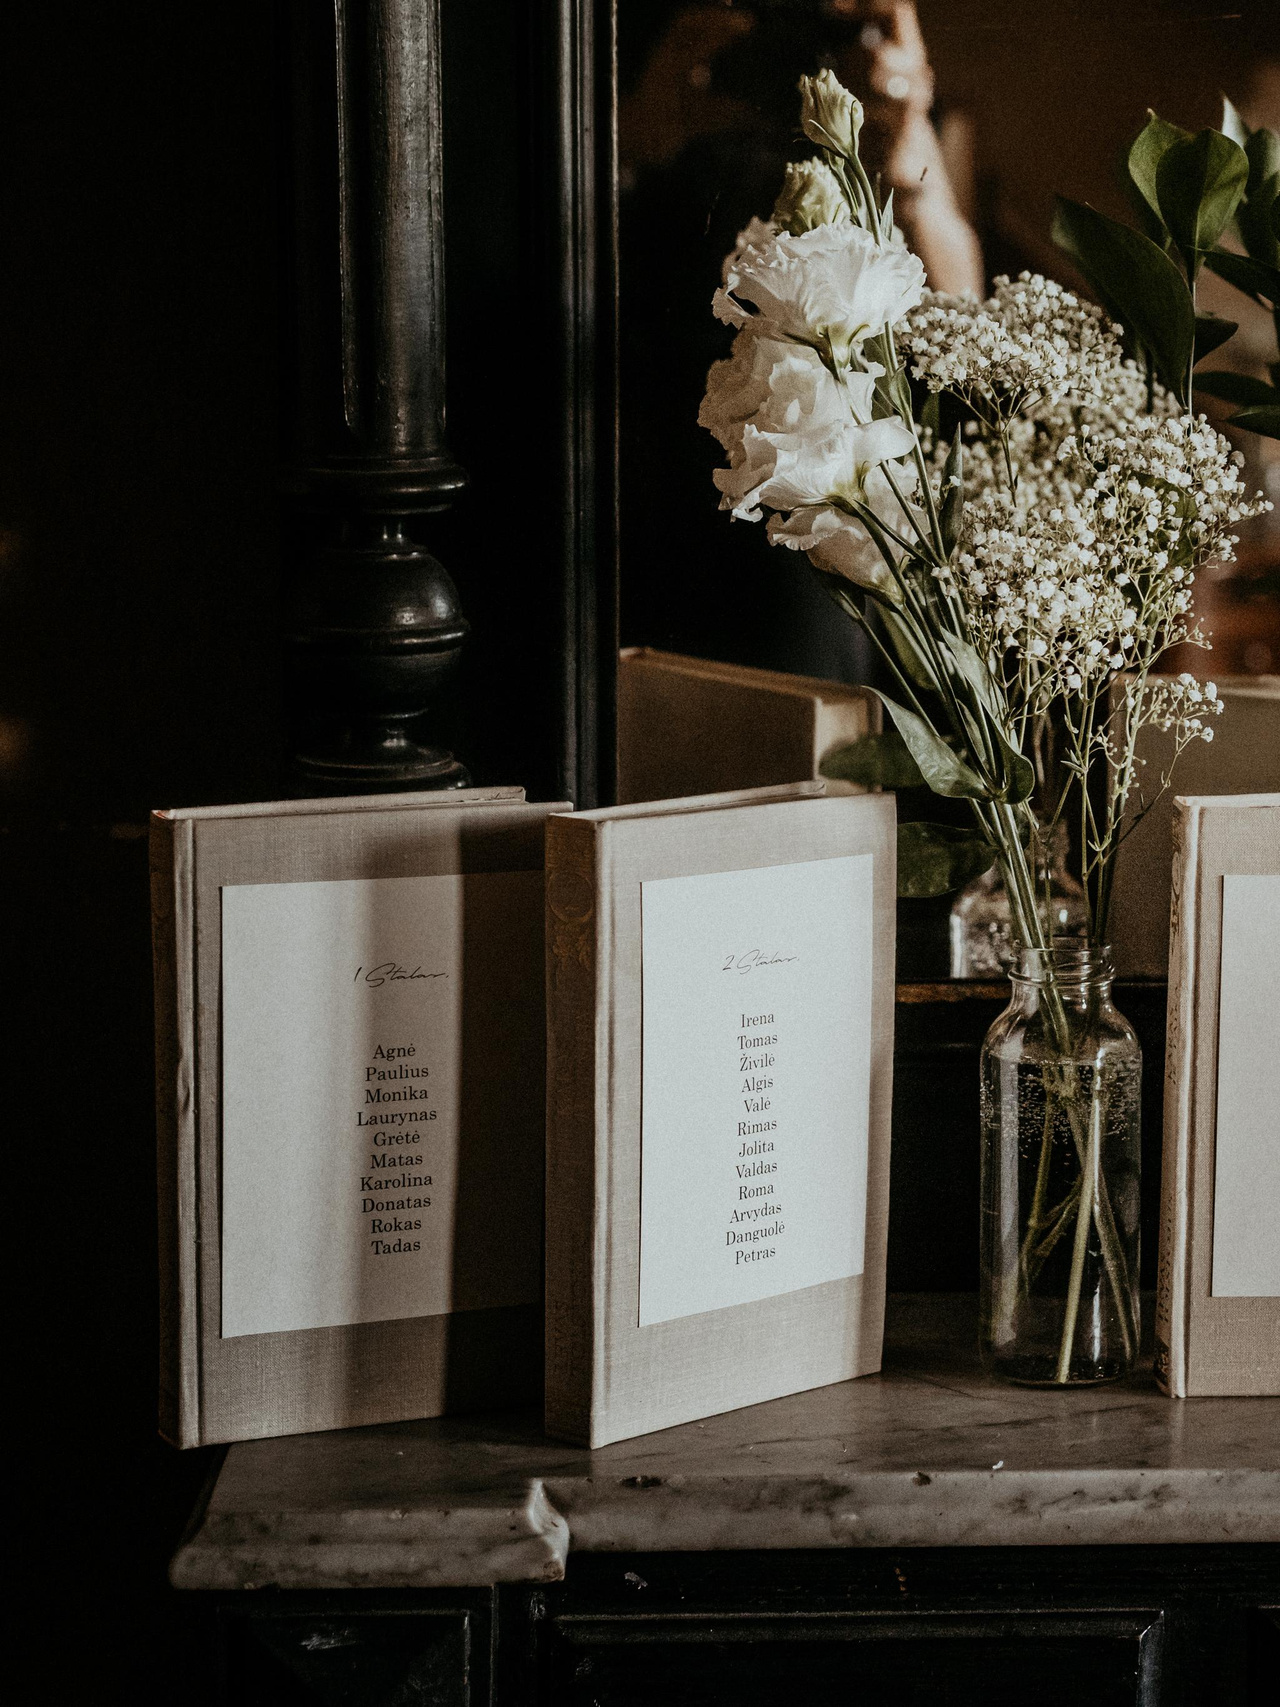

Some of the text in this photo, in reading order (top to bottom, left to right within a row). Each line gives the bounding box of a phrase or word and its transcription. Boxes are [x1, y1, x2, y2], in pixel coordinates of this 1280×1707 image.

[722, 955, 735, 971] 2
[354, 967, 362, 982] 1
[741, 1013, 775, 1028] Irena
[737, 1034, 778, 1050] Tomas
[373, 1043, 416, 1061] Agnė
[740, 1053, 775, 1072] Živilė
[365, 1064, 429, 1081] Paulius
[741, 1075, 774, 1093] Algis
[365, 1086, 428, 1104] Monika
[744, 1097, 771, 1112] Valė
[356, 1110, 437, 1127] Laurynas
[738, 1120, 777, 1136] Rimas
[374, 1130, 420, 1146] Grėtė
[739, 1140, 774, 1157] Jolita
[370, 1153, 423, 1169] Matas
[736, 1161, 778, 1179] Valdas
[360, 1173, 433, 1191] Karolina
[739, 1184, 774, 1200] Roma
[362, 1196, 431, 1213] Donatas
[730, 1202, 782, 1223] Arvydas
[371, 1218, 422, 1234] Rokas
[726, 1221, 786, 1246] Danguolė
[371, 1239, 421, 1255] Tadas
[735, 1247, 776, 1265] Petras
